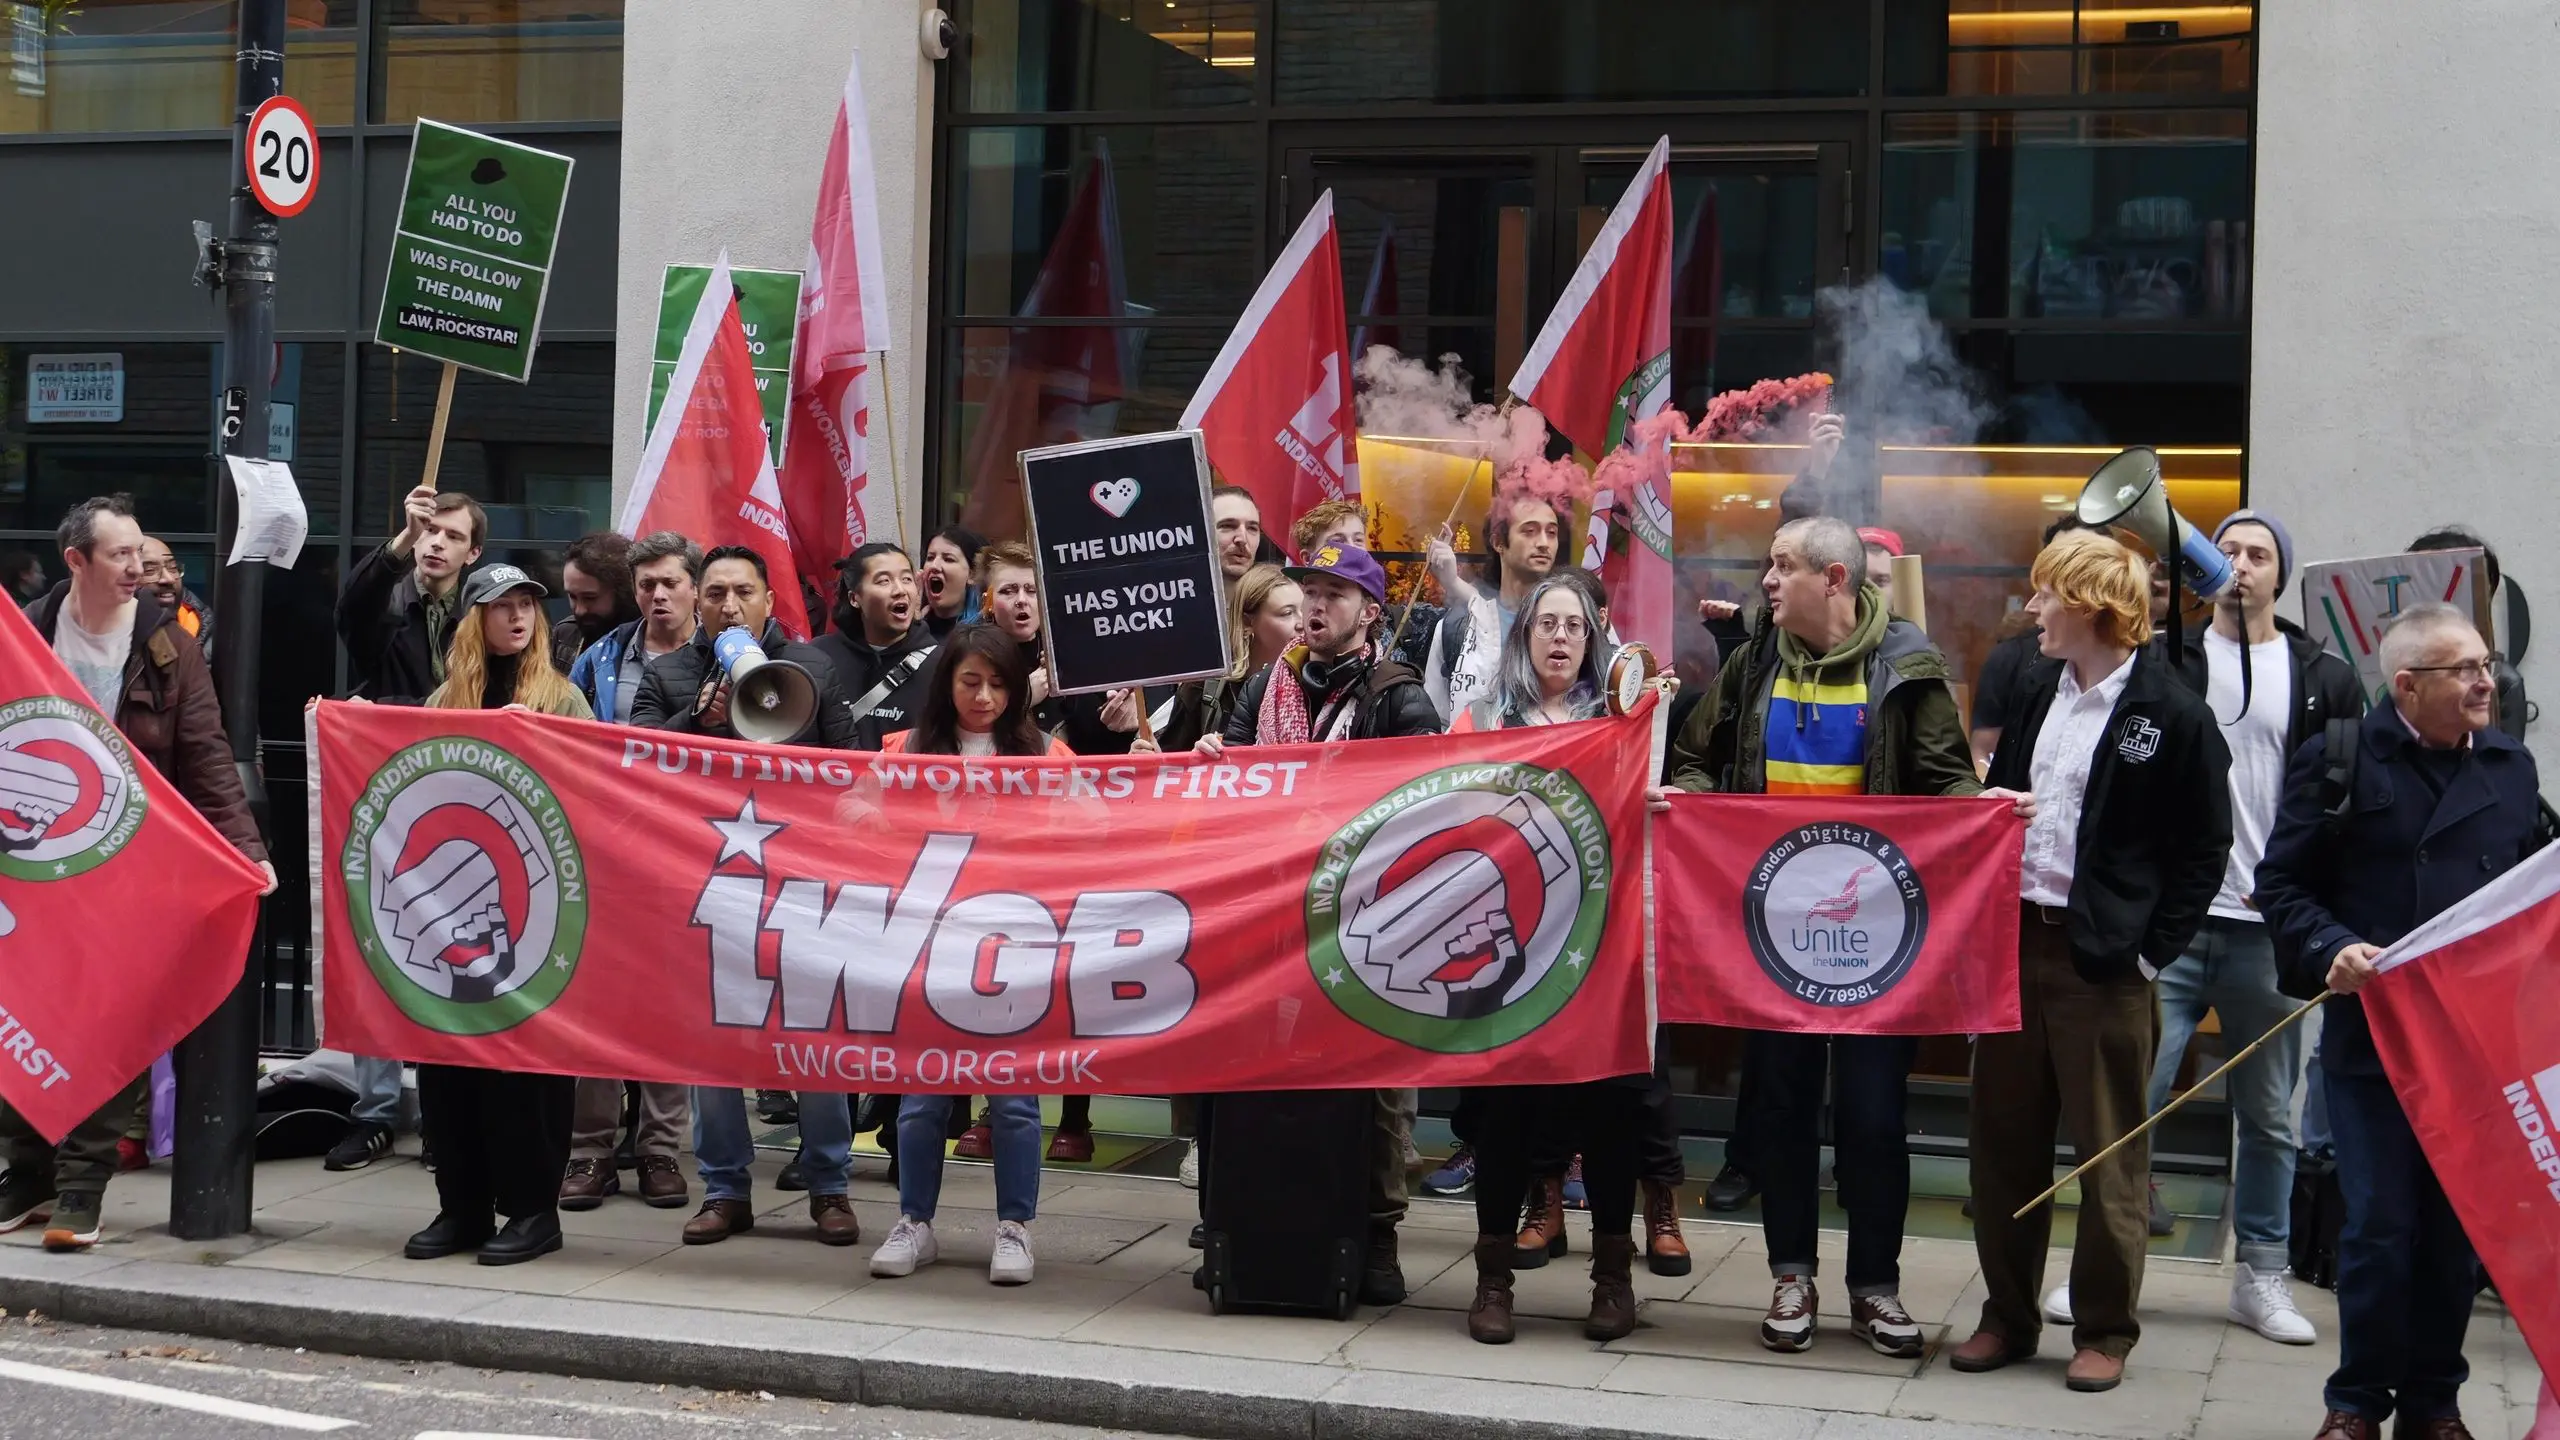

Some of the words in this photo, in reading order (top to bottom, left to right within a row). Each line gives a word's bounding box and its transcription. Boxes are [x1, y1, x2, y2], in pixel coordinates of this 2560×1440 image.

[260, 130, 309, 184] 20
[431, 210, 468, 231] HAD
[472, 220, 494, 238] TO
[496, 227, 522, 246] DO
[445, 194, 477, 214] ALL
[482, 202, 516, 224] YOU
[410, 248, 447, 271] WAS
[450, 260, 521, 290] FOLLOW
[416, 276, 450, 298] THE
[451, 286, 502, 312] DAMN
[400, 312, 433, 331] LAW,
[435, 318, 518, 344] ROCKSTAR!
[1053, 538, 1106, 564] THE
[1111, 525, 1195, 556] UNION
[1065, 588, 1119, 614] HAS
[1122, 578, 1196, 606] YOUR
[1094, 607, 1174, 637] BACK!
[98, 723, 145, 803] WORKERS
[621, 738, 853, 786] PUTTING
[868, 763, 1136, 799] WORKERS
[1153, 761, 1307, 799] FIRST
[97, 806, 142, 857] UNION
[346, 746, 433, 881] INDEPENDENT
[440, 743, 545, 807] WORKERS
[541, 807, 582, 902] UNION
[1312, 776, 1442, 915] INDEPENDENT
[1450, 767, 1567, 798] WORKRS
[1560, 794, 1605, 890] UNION
[1752, 840, 1795, 892] London
[1800, 824, 1870, 848] Digital
[1877, 844, 1889, 859] &
[1892, 858, 1920, 900] Tech
[1791, 925, 1869, 953] unite
[1796, 980, 1879, 1003] LE/7098L
[772, 1042, 1102, 1085] IWGB.ORG.UK
